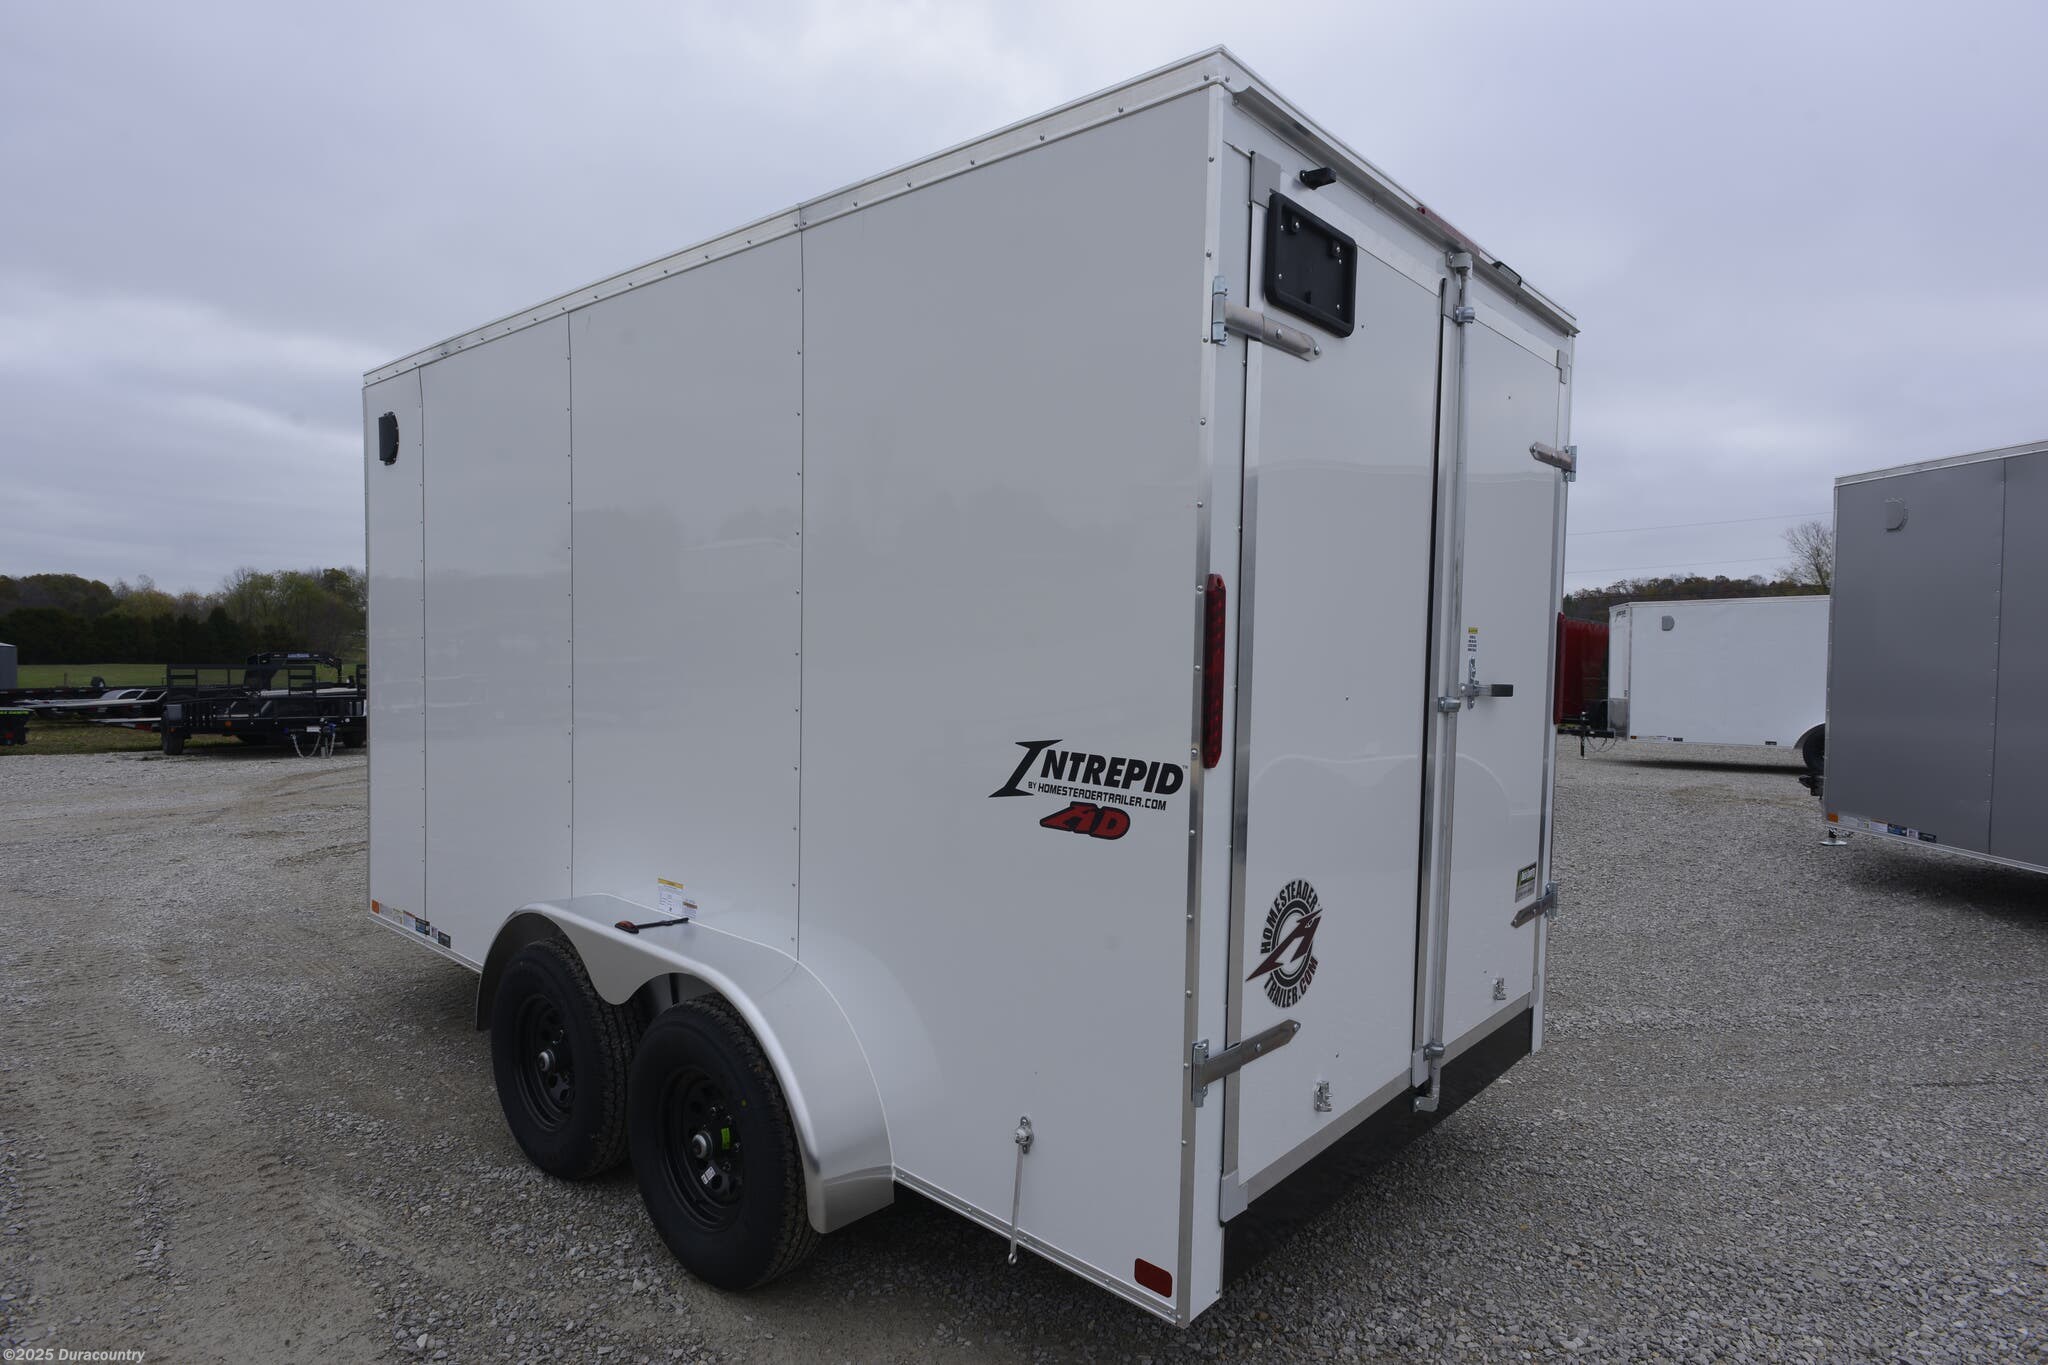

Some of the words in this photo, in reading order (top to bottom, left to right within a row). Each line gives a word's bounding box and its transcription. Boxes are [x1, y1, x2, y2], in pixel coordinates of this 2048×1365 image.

[988, 739, 1184, 798] INTREPID
[1027, 781, 1038, 789] BY
[1038, 783, 1167, 811] HOMESTEADERTRAILER.COM
[1260, 879, 1319, 954] HOMESTEADER
[1263, 955, 1319, 1009] TRAILER.COM
